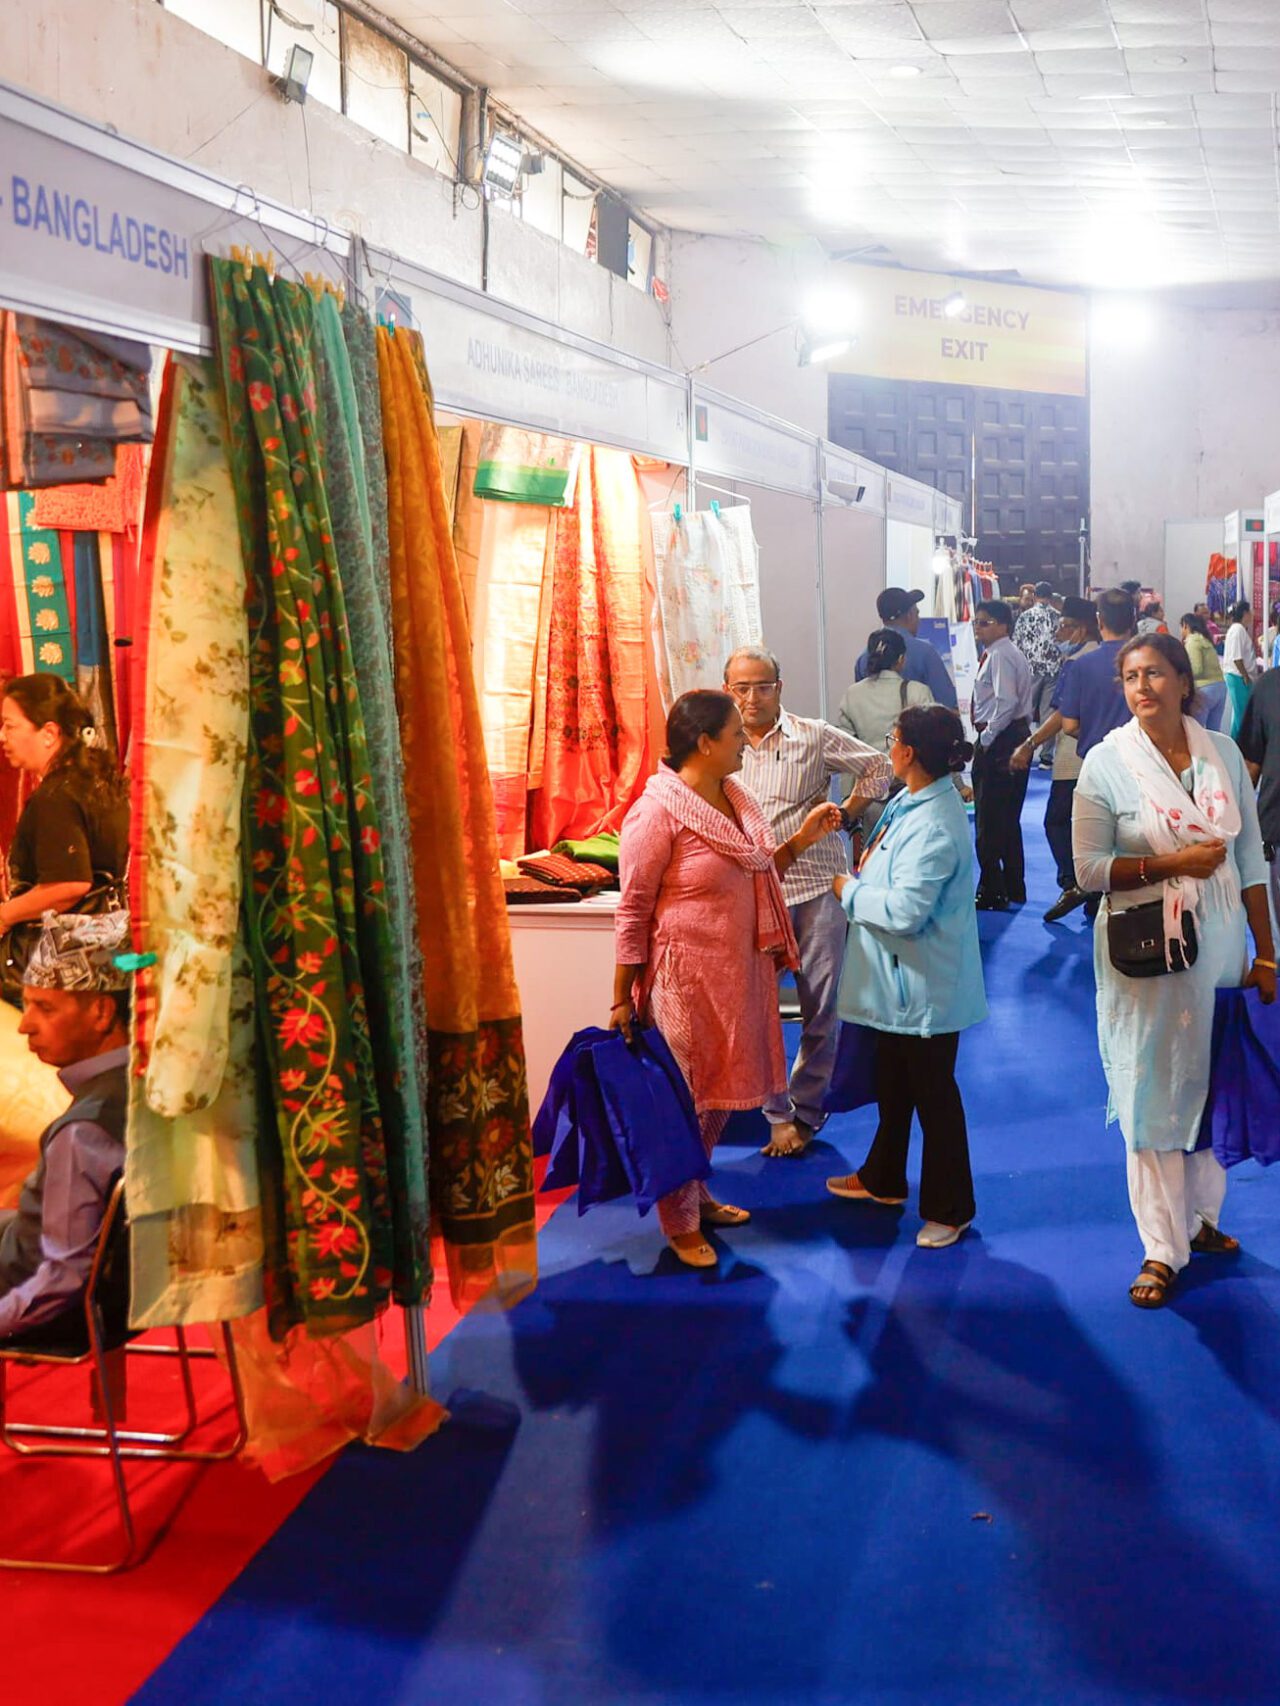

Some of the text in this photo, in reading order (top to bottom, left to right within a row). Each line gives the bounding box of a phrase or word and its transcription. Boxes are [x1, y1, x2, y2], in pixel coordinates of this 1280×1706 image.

[12, 175, 188, 280] BANGLADESH
[895, 294, 1030, 331] EMEGENCY
[466, 336, 521, 382] ADHUNIKA
[941, 338, 989, 362] EXIT
